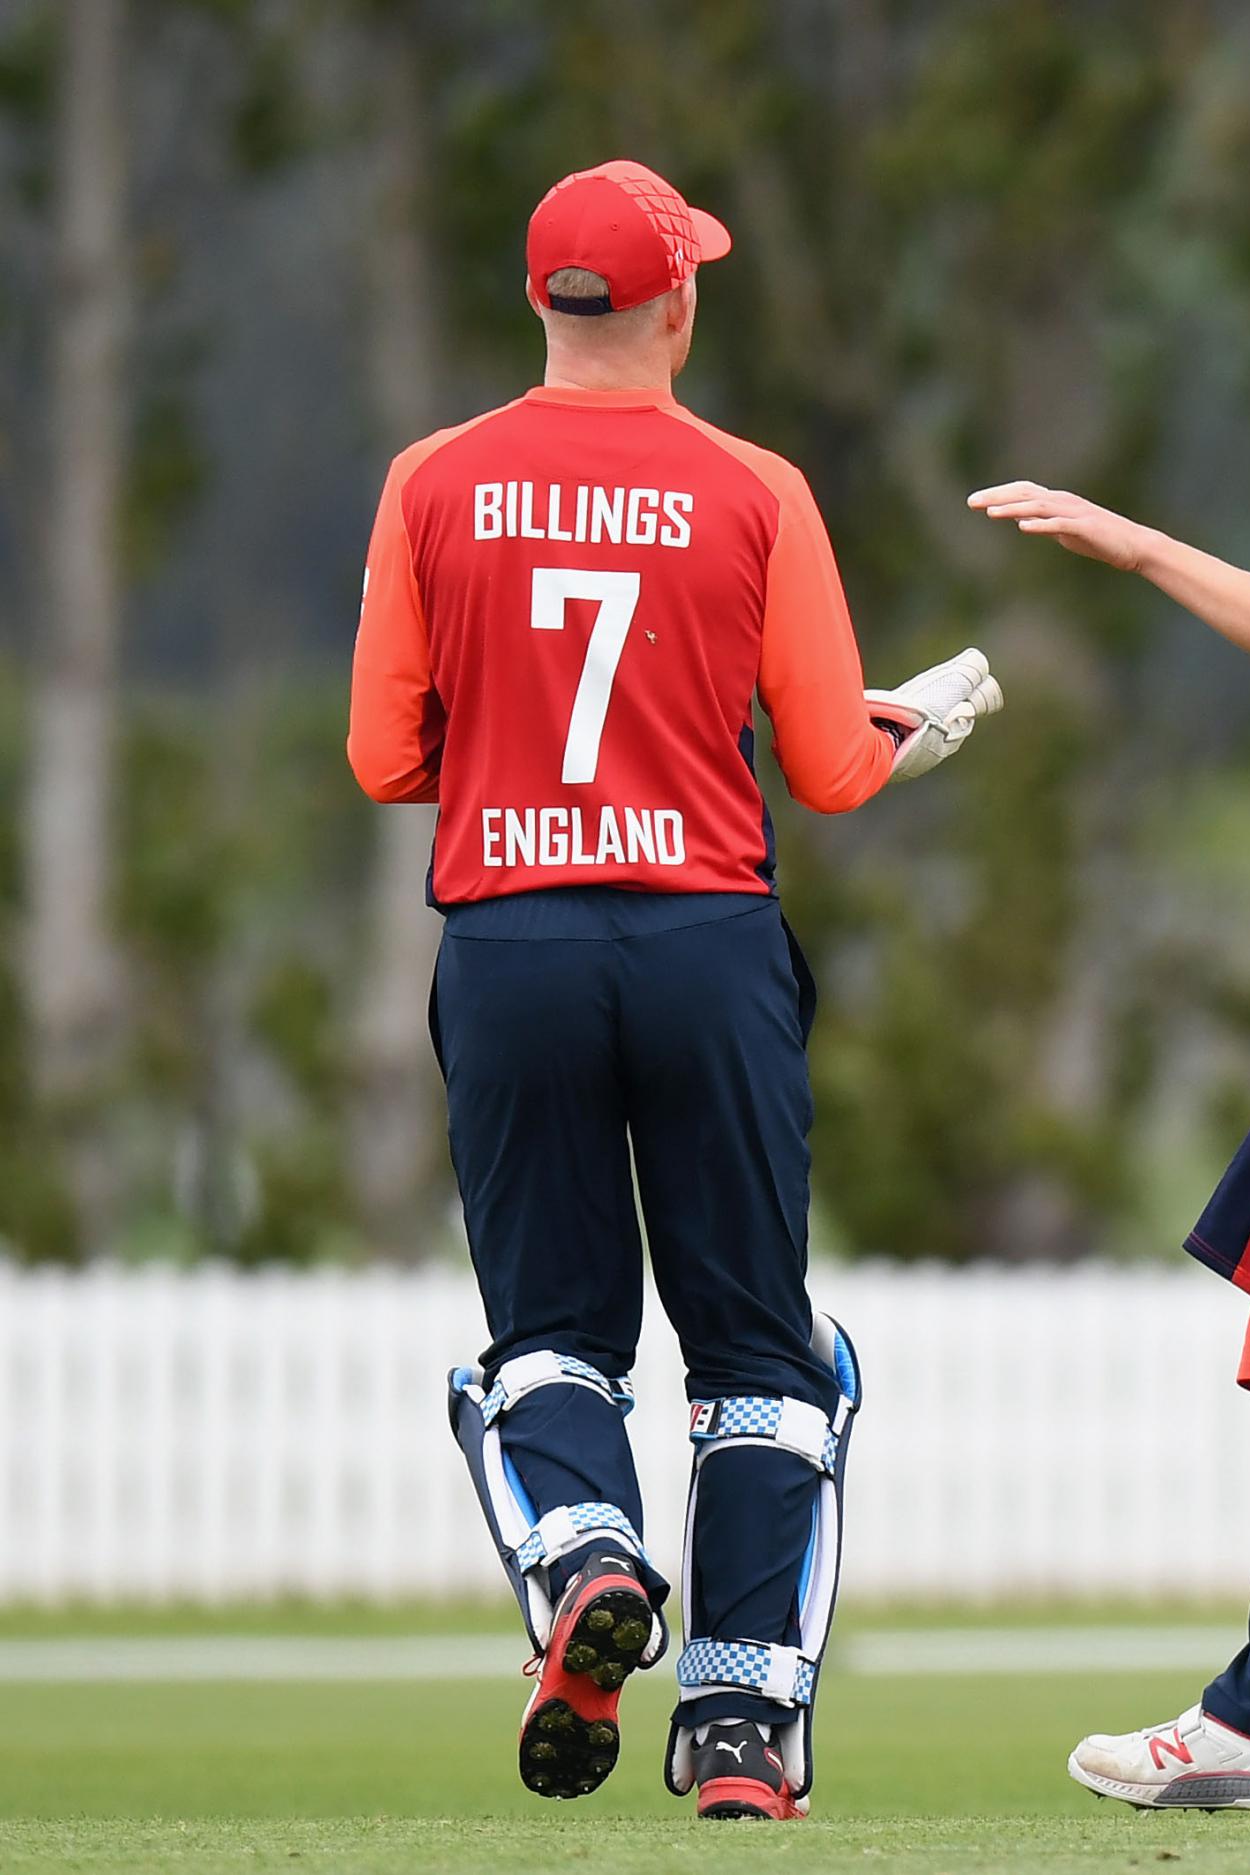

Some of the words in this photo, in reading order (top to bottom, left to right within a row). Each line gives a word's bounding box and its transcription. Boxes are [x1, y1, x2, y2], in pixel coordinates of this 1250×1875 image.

[474, 481, 694, 548] BILLINGS
[531, 568, 641, 784] 7
[482, 806, 686, 867] ENGLAND
